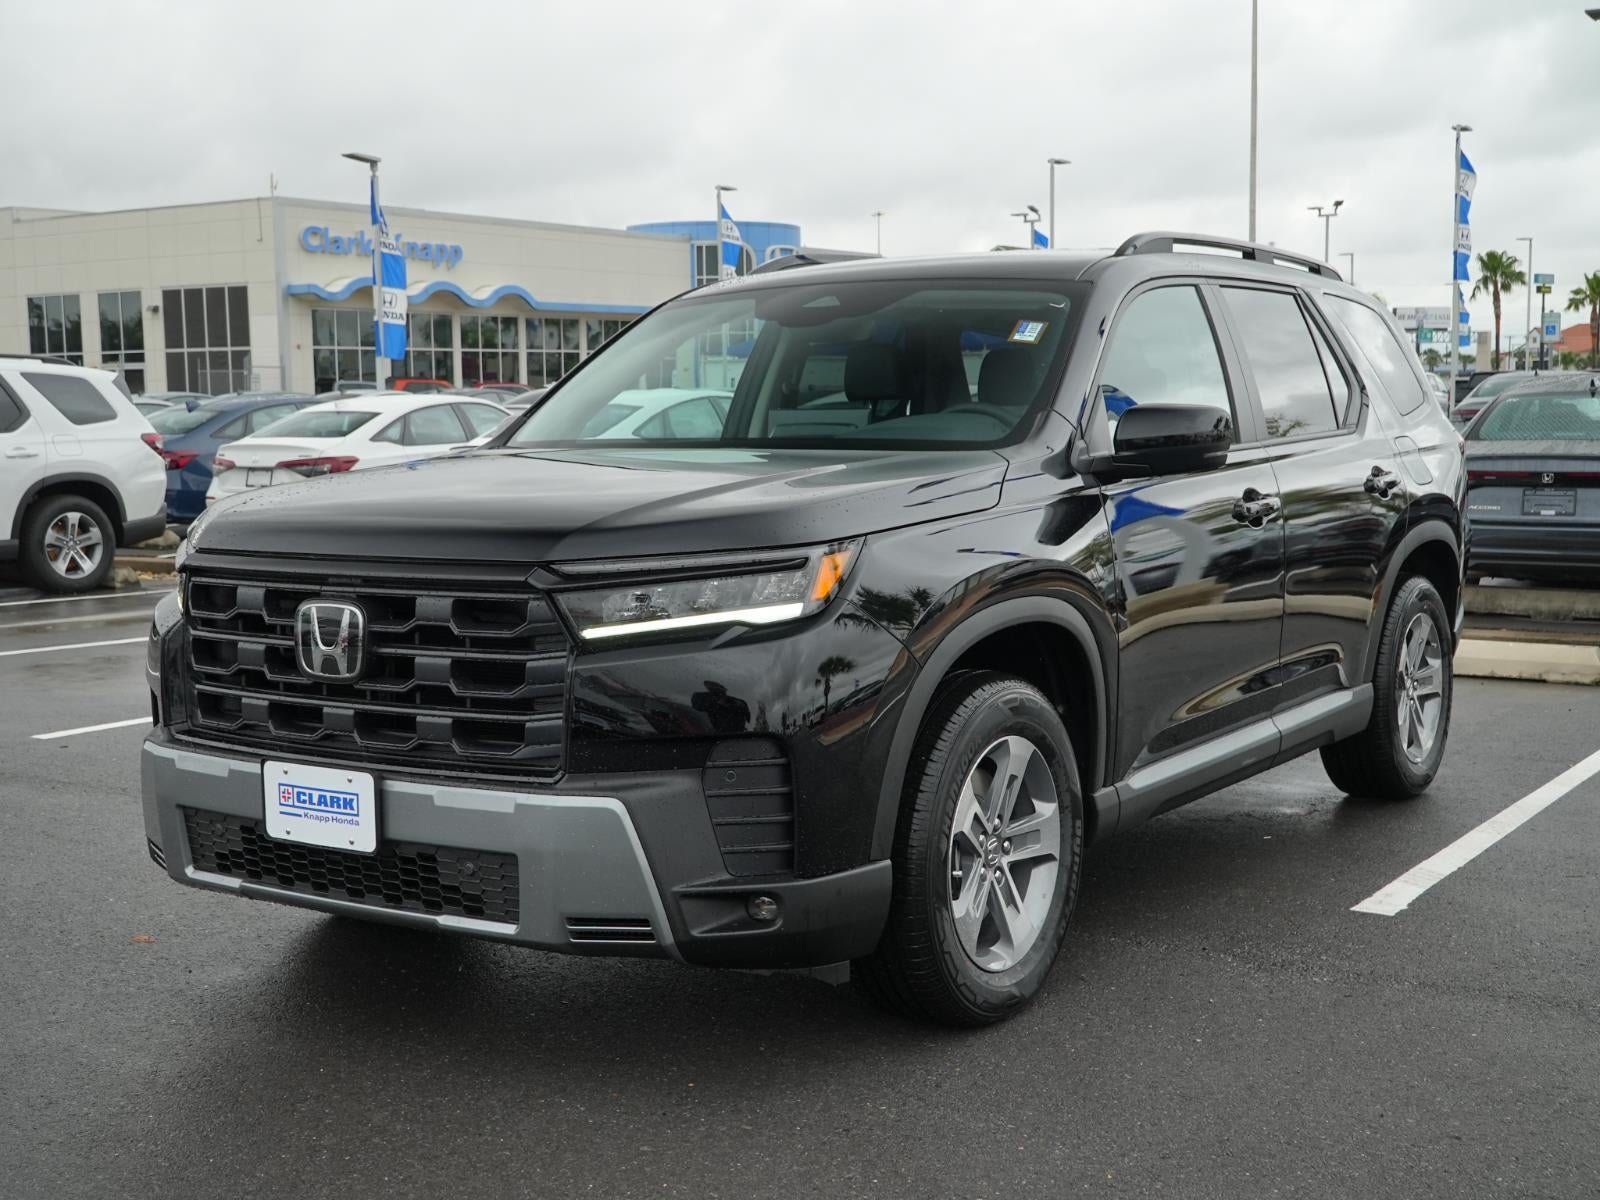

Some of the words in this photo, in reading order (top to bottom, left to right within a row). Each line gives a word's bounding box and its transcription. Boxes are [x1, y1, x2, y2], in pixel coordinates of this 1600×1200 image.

[302, 225, 372, 257] Clark
[383, 311, 405, 321] NDA
[296, 791, 355, 810] CLARK
[303, 811, 330, 823] Knapp
[331, 816, 360, 827] Honda
